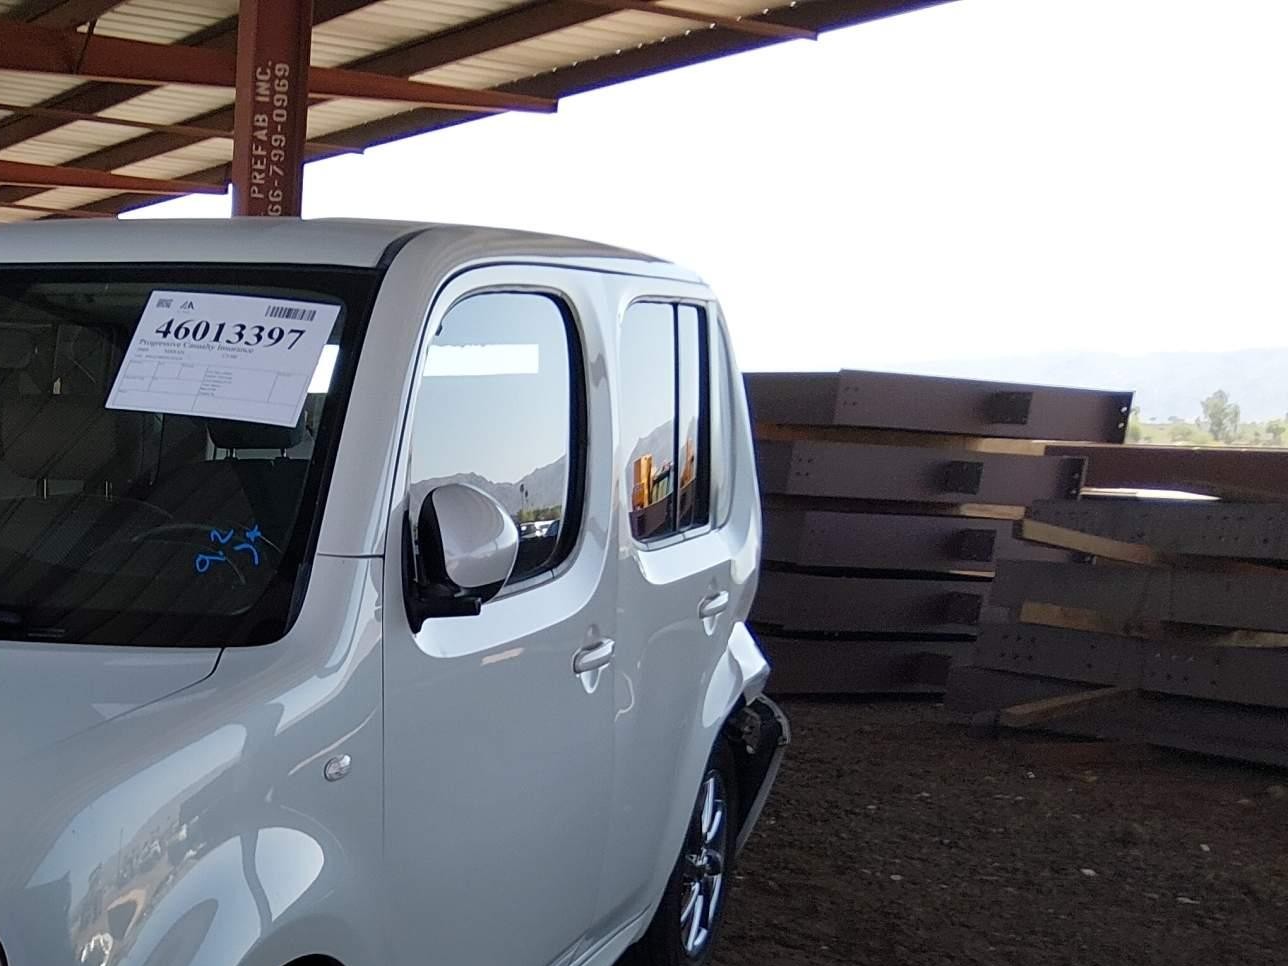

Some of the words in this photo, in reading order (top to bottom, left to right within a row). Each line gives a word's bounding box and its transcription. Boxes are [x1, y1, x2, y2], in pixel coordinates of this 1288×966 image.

[255, 60, 274, 103] INC.
[250, 113, 269, 199] PREFAB
[139, 338, 181, 349] Progressive
[217, 344, 254, 354] Insurance
[155, 318, 306, 350] 46013397
